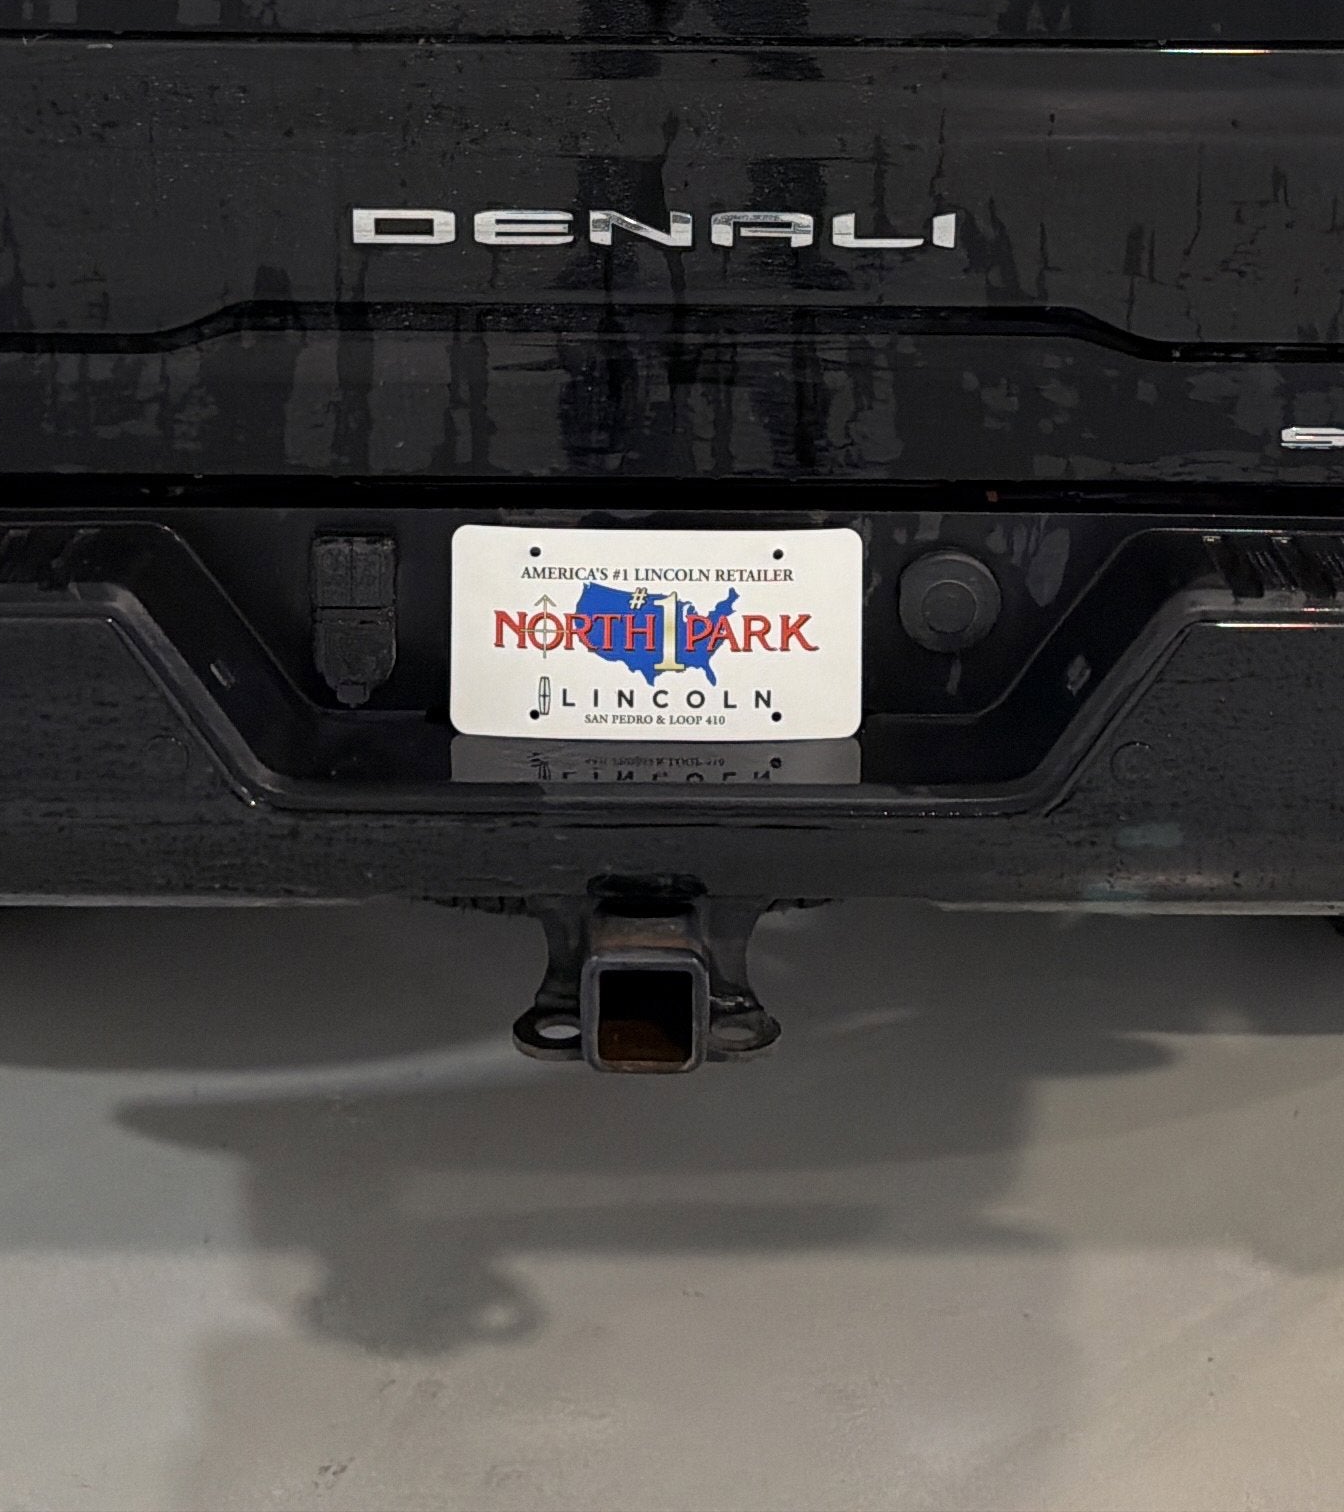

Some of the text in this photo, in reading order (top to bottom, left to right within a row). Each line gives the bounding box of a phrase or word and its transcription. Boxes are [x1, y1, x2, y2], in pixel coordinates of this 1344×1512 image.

[352, 208, 956, 249] DENALI
[520, 566, 794, 583] AMERICA'S #1 LINCOLN RETAILER
[494, 610, 820, 653] NORTH PARK
[562, 688, 772, 709] LINCOLN
[584, 713, 726, 726] SAN PEDRO & LOOP 410
